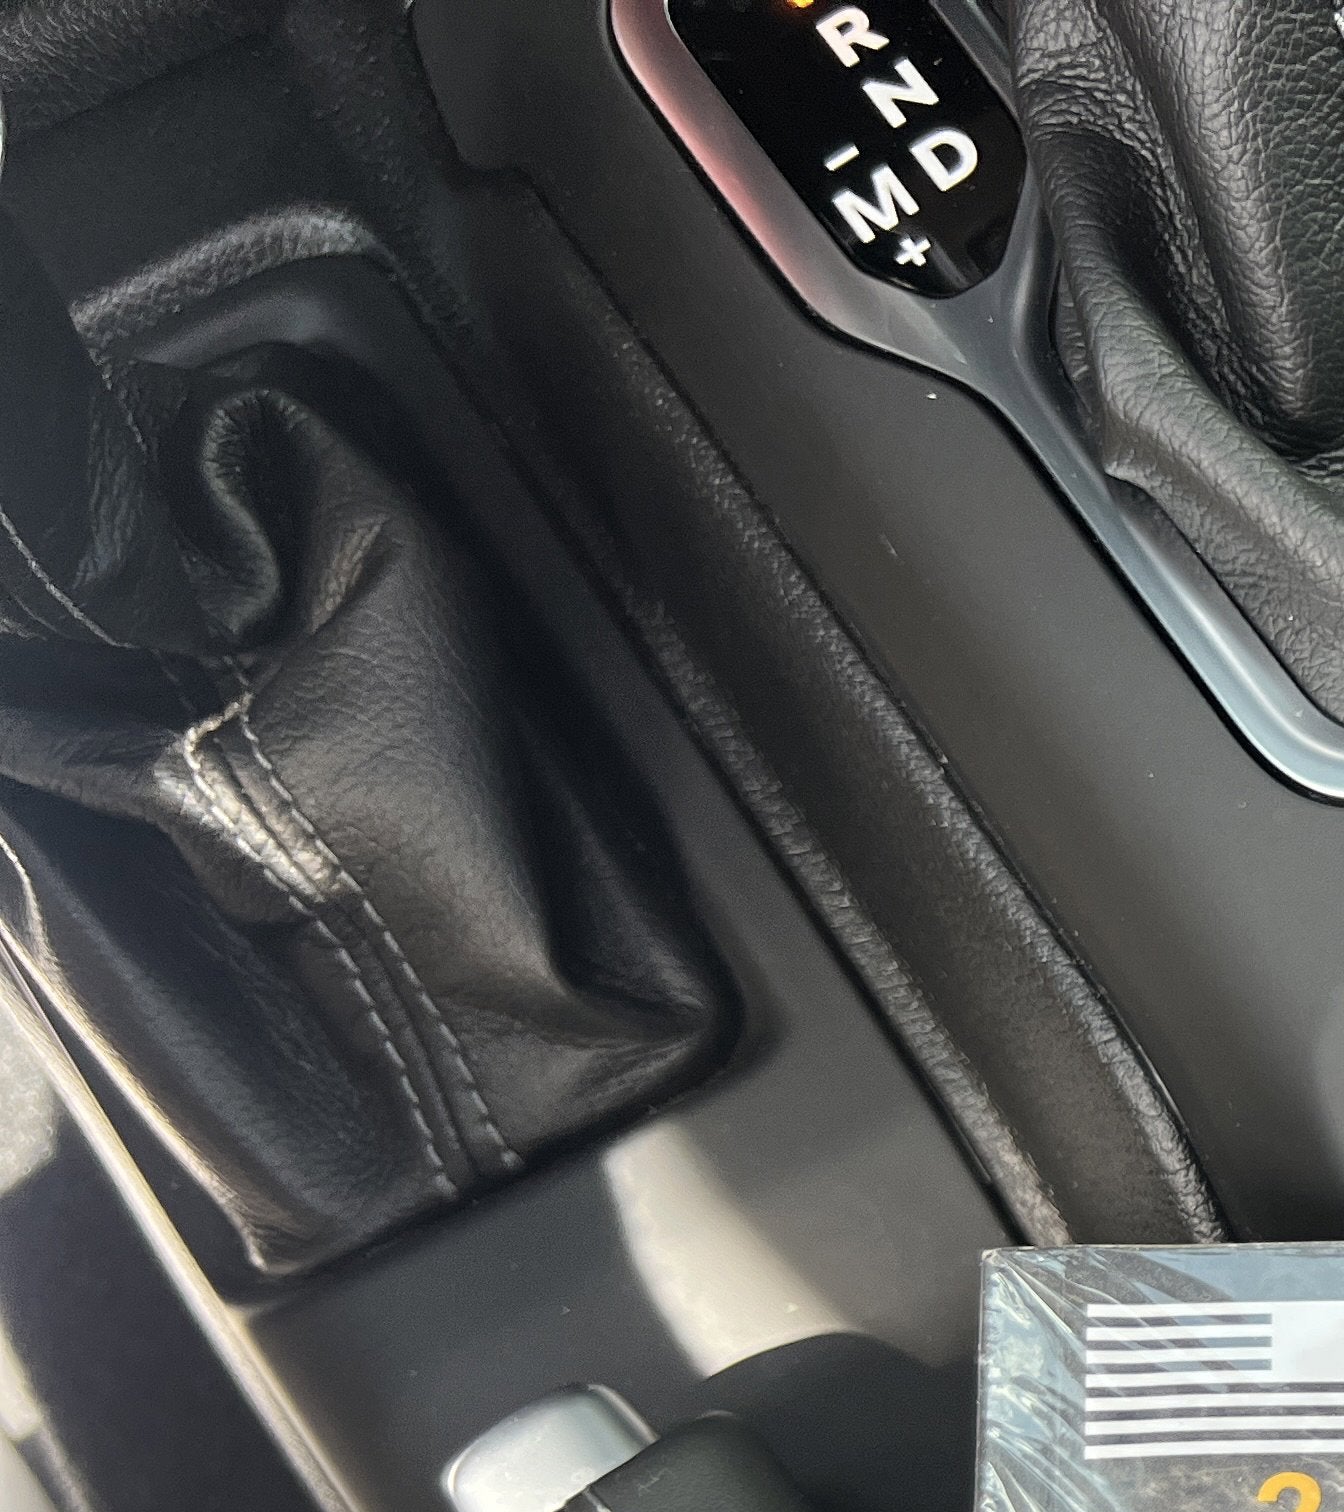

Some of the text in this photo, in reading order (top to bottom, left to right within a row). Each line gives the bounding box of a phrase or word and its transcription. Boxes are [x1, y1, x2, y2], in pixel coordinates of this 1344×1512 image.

[815, 5, 890, 68] R
[861, 58, 939, 128] N
[908, 127, 979, 192] D
[831, 164, 920, 244] M
